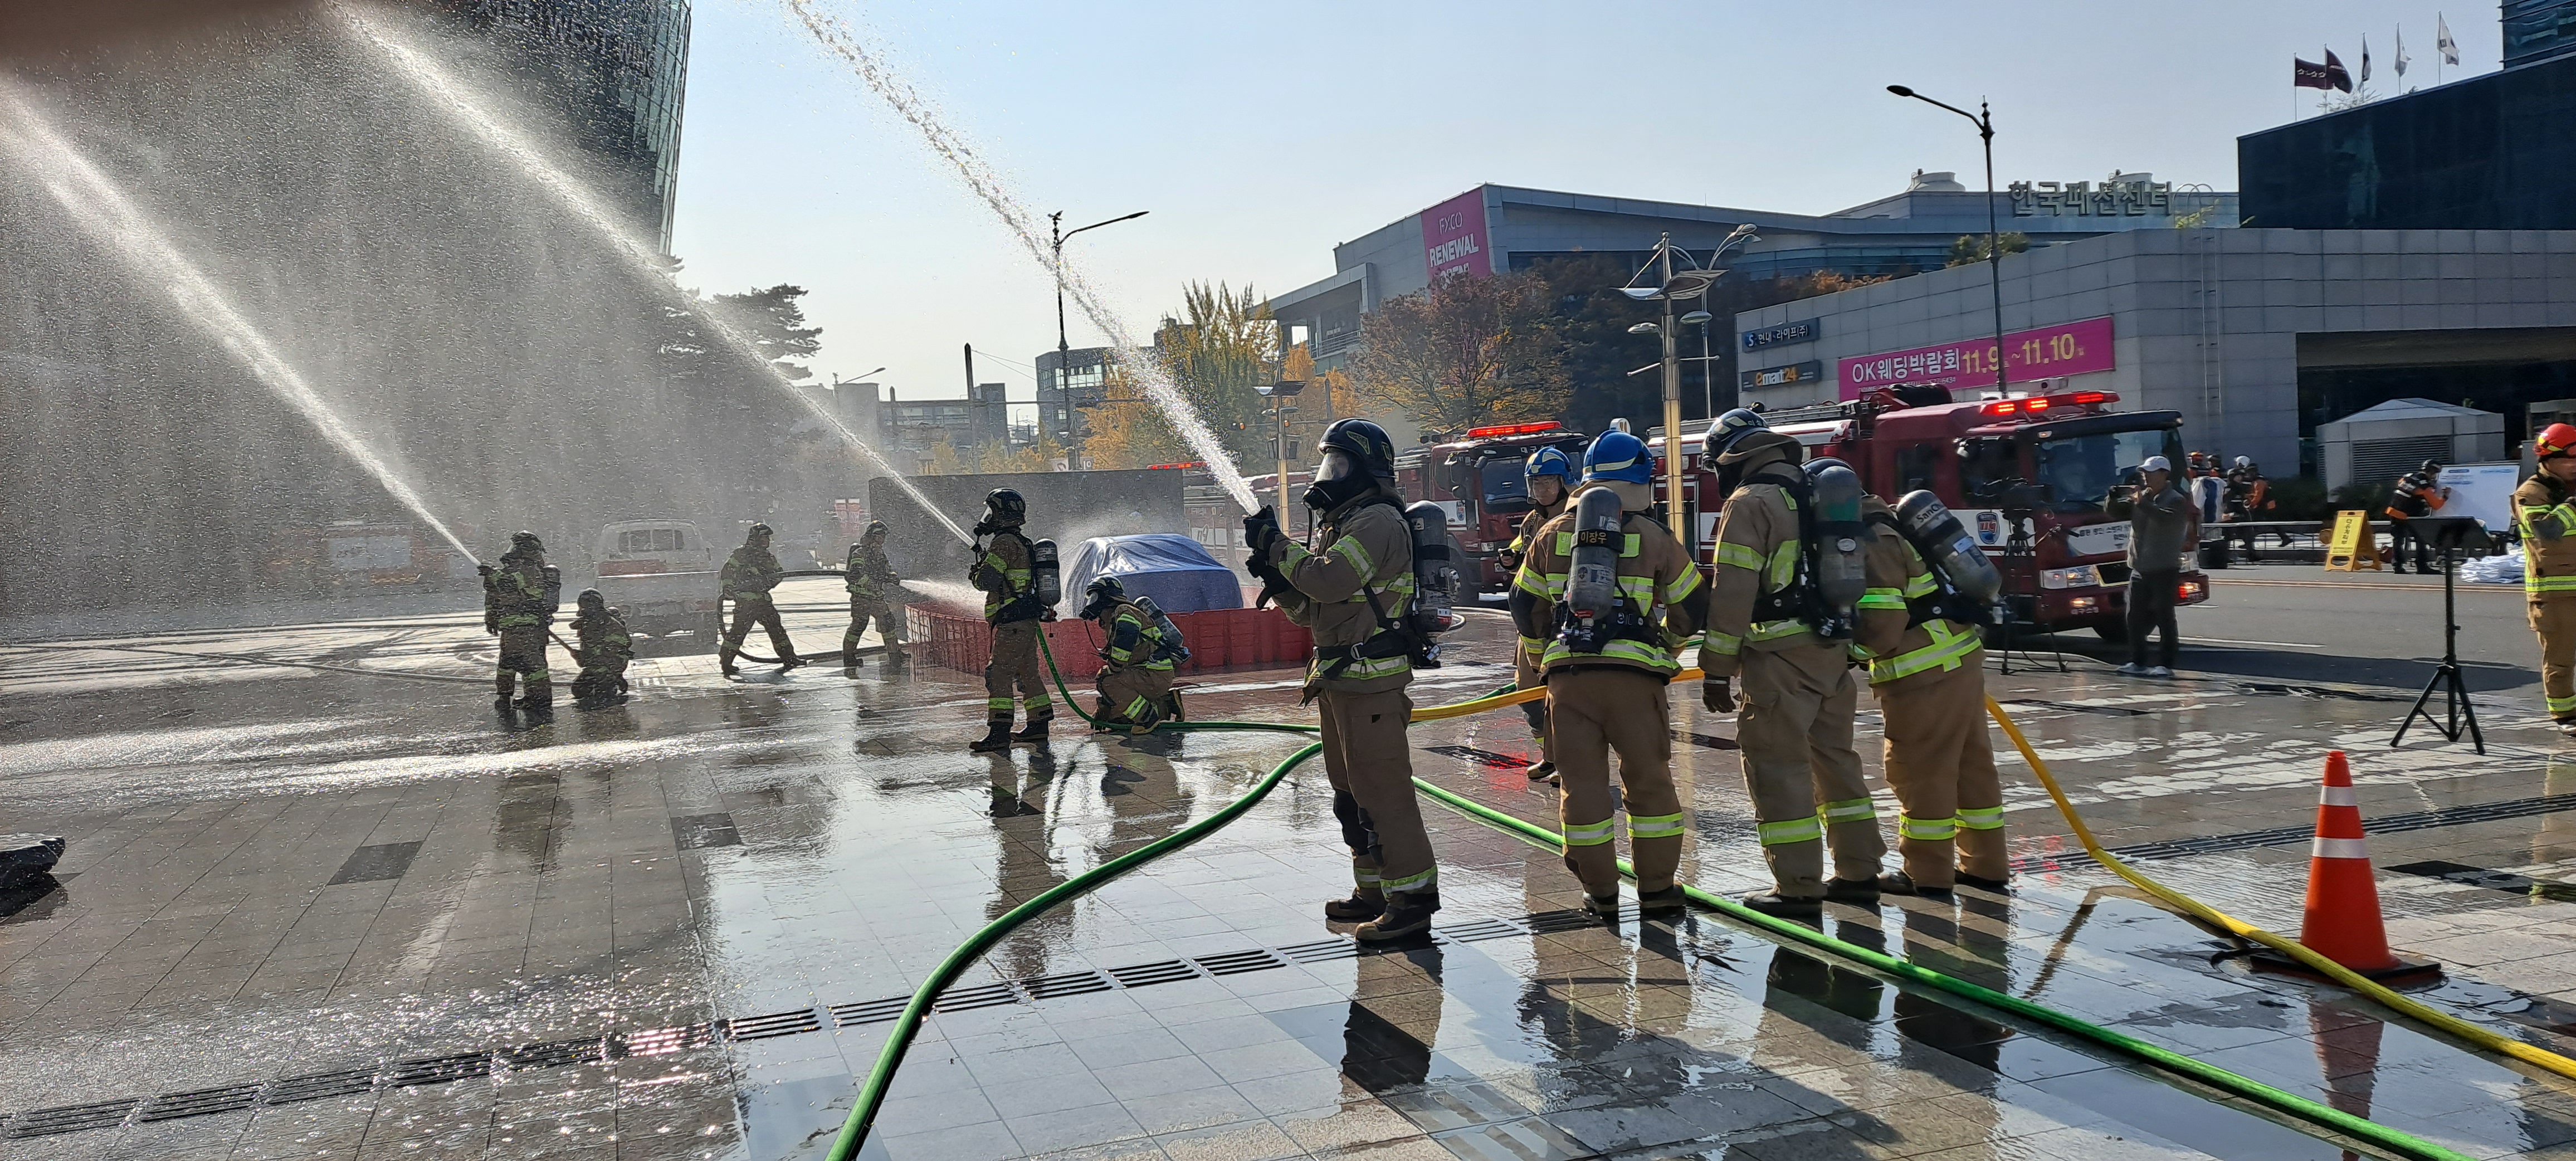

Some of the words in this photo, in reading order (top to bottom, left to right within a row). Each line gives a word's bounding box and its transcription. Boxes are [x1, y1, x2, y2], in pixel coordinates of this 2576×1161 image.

[2008, 181, 2172, 216] 한국패션센터
[1439, 212, 1463, 235] FXCO
[1429, 233, 1479, 267] RENEWAL
[1852, 348, 1960, 383] OK웨딩박람회
